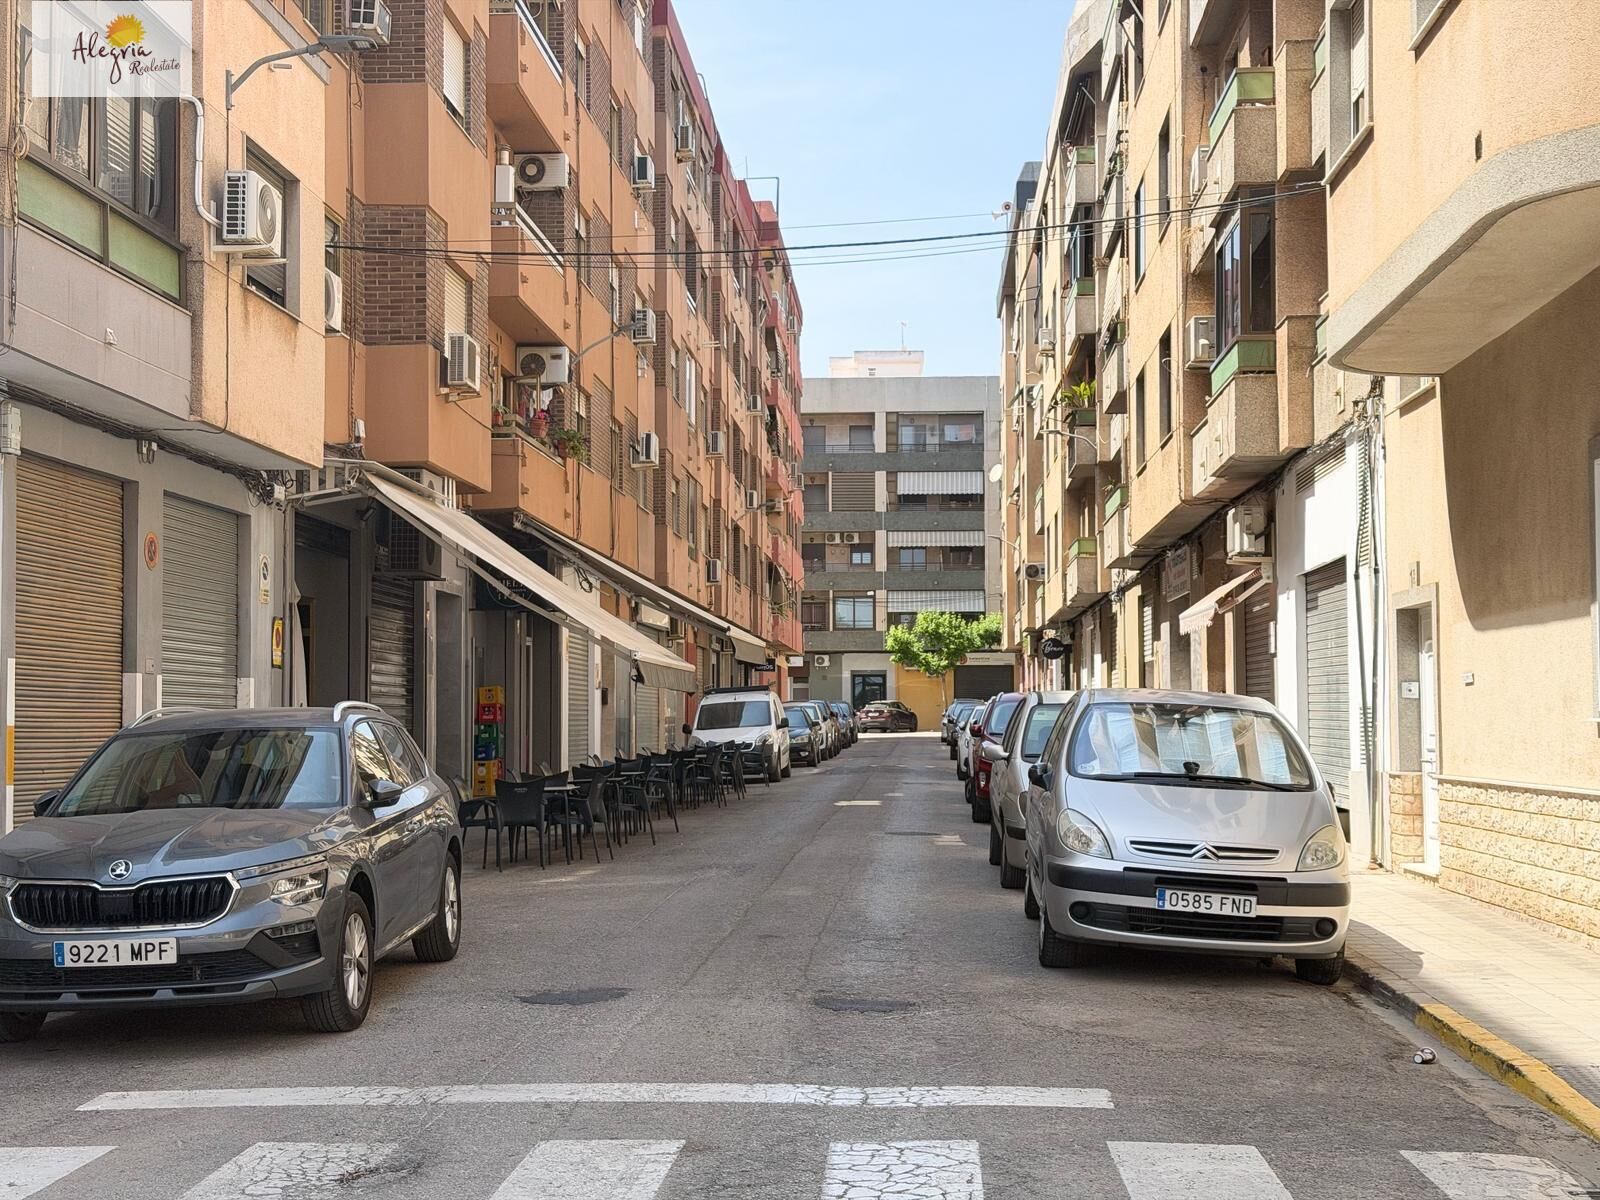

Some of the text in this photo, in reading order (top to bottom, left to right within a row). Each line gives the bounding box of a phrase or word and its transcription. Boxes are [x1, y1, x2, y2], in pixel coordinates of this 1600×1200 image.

[1169, 892, 1213, 910] 0585
[1219, 896, 1253, 914] FND
[69, 944, 119, 963] 9221
[130, 941, 170, 962] MPF
